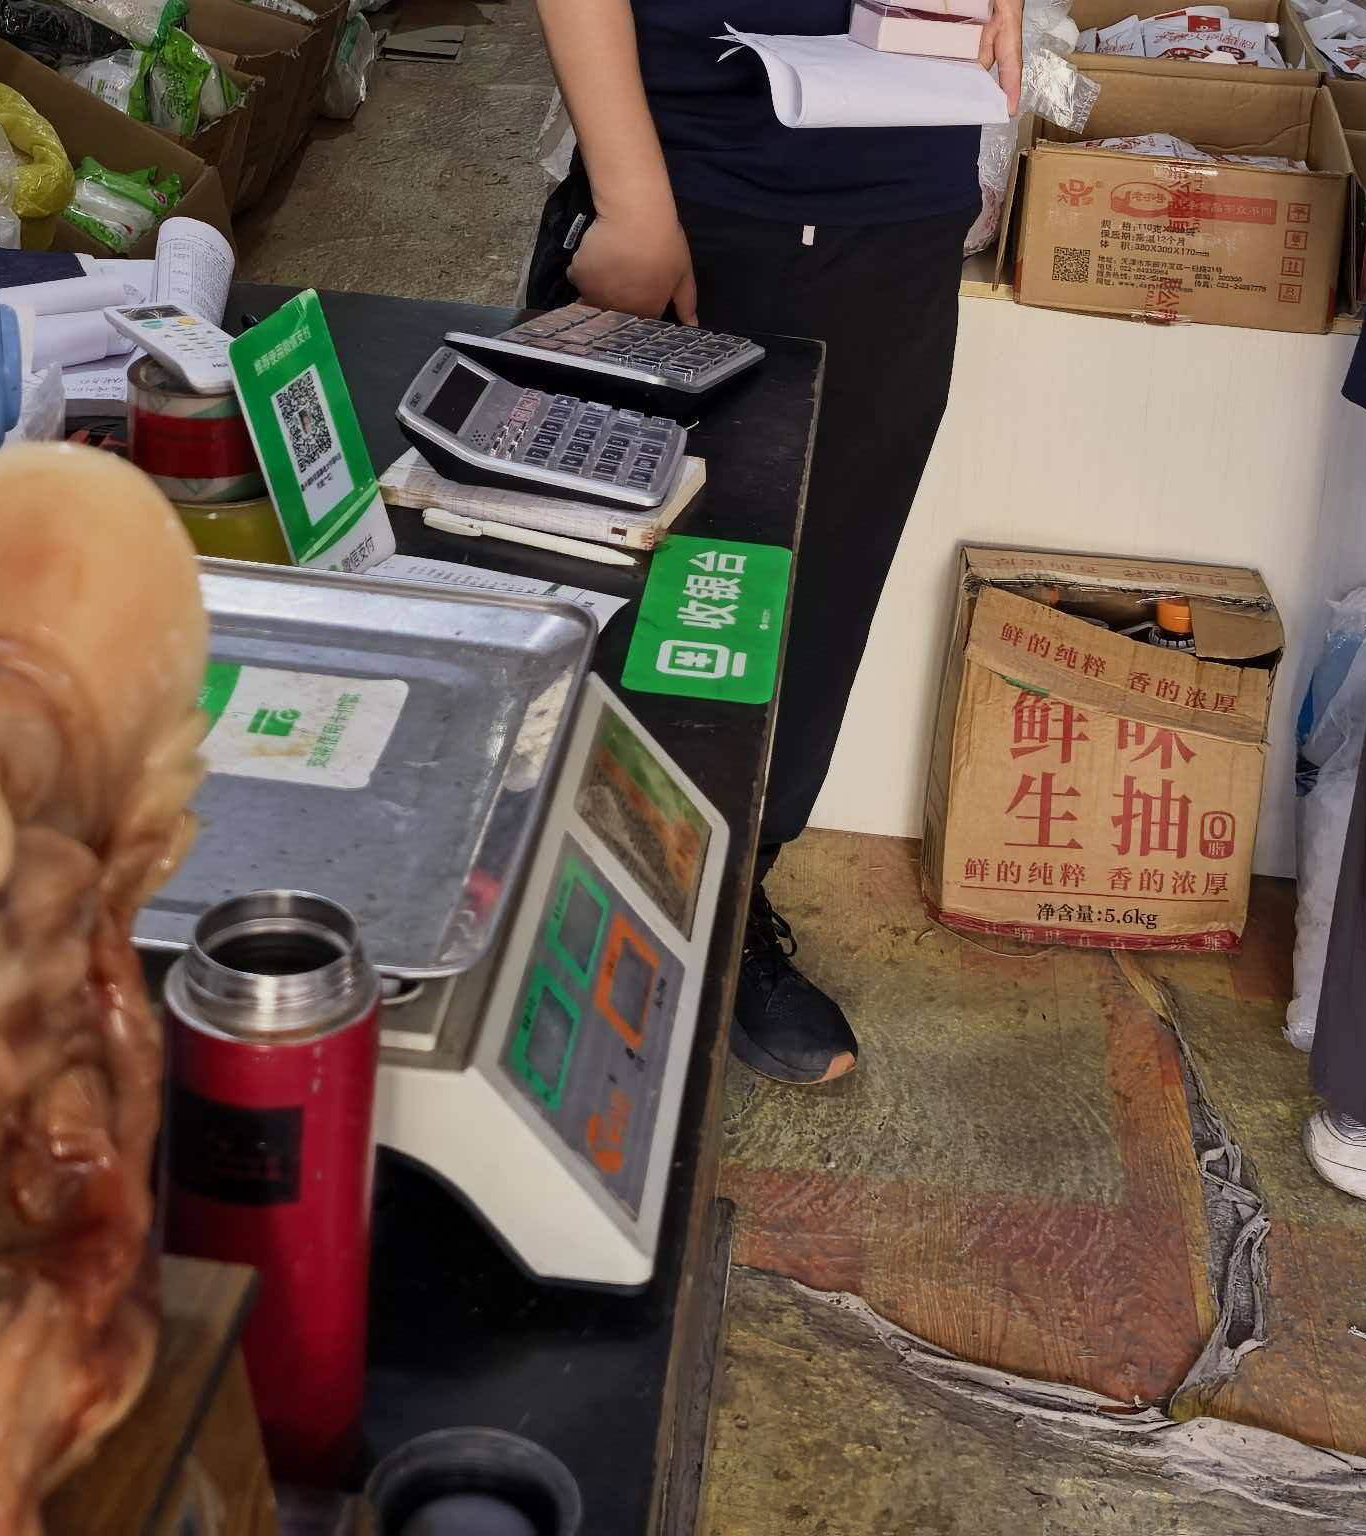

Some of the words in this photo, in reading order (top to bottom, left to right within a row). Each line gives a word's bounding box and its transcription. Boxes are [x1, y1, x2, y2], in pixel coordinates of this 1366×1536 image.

[677, 549, 747, 630] 收银台
[1001, 622, 1107, 678] 鲜的纯粹
[1128, 671, 1239, 714] 香的浓厚
[1009, 690, 1198, 771] 鲜味
[1004, 771, 1192, 859] 生抽
[1208, 815, 1228, 838] 0
[964, 857, 1088, 889] 鲜的纯粹
[1107, 866, 1229, 896] 香的浓厚
[1036, 902, 1159, 930] 净含量:5.6kg
